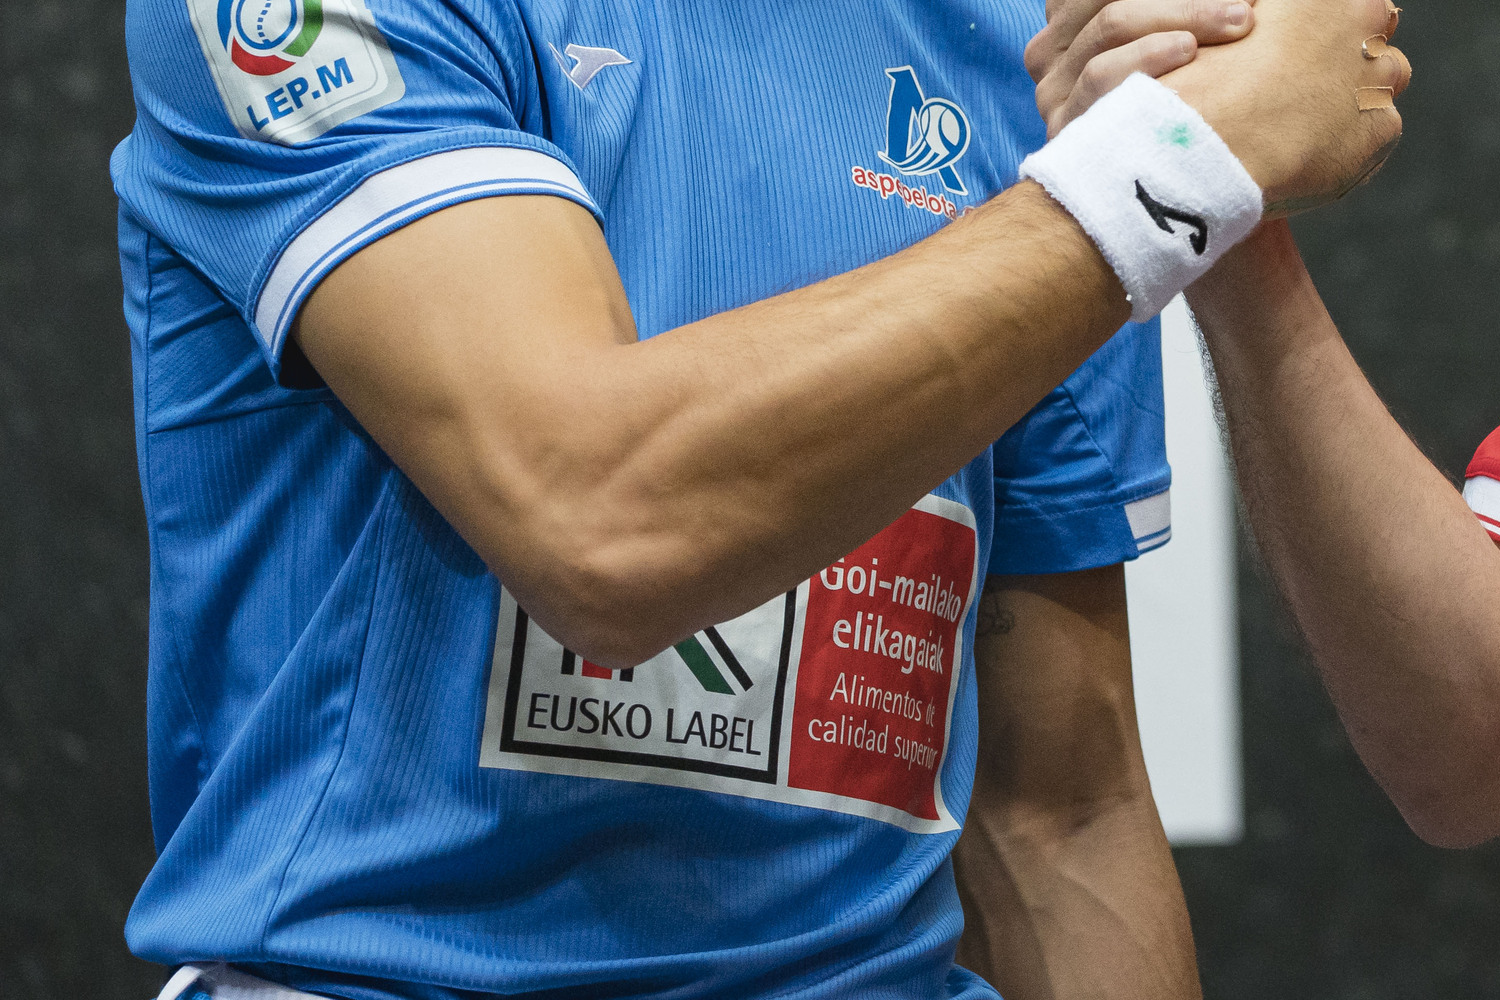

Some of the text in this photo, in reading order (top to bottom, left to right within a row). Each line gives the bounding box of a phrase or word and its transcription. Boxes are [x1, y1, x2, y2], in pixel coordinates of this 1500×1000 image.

[246, 56, 355, 132] LEP.M
[852, 166, 975, 221] aspepelota
[820, 557, 962, 623] Goi-mailako
[832, 610, 944, 675] elikagaiak
[526, 692, 762, 756] EUSKO LABEL
[829, 671, 936, 728] Alimentos de
[807, 714, 938, 772] calidad superior
